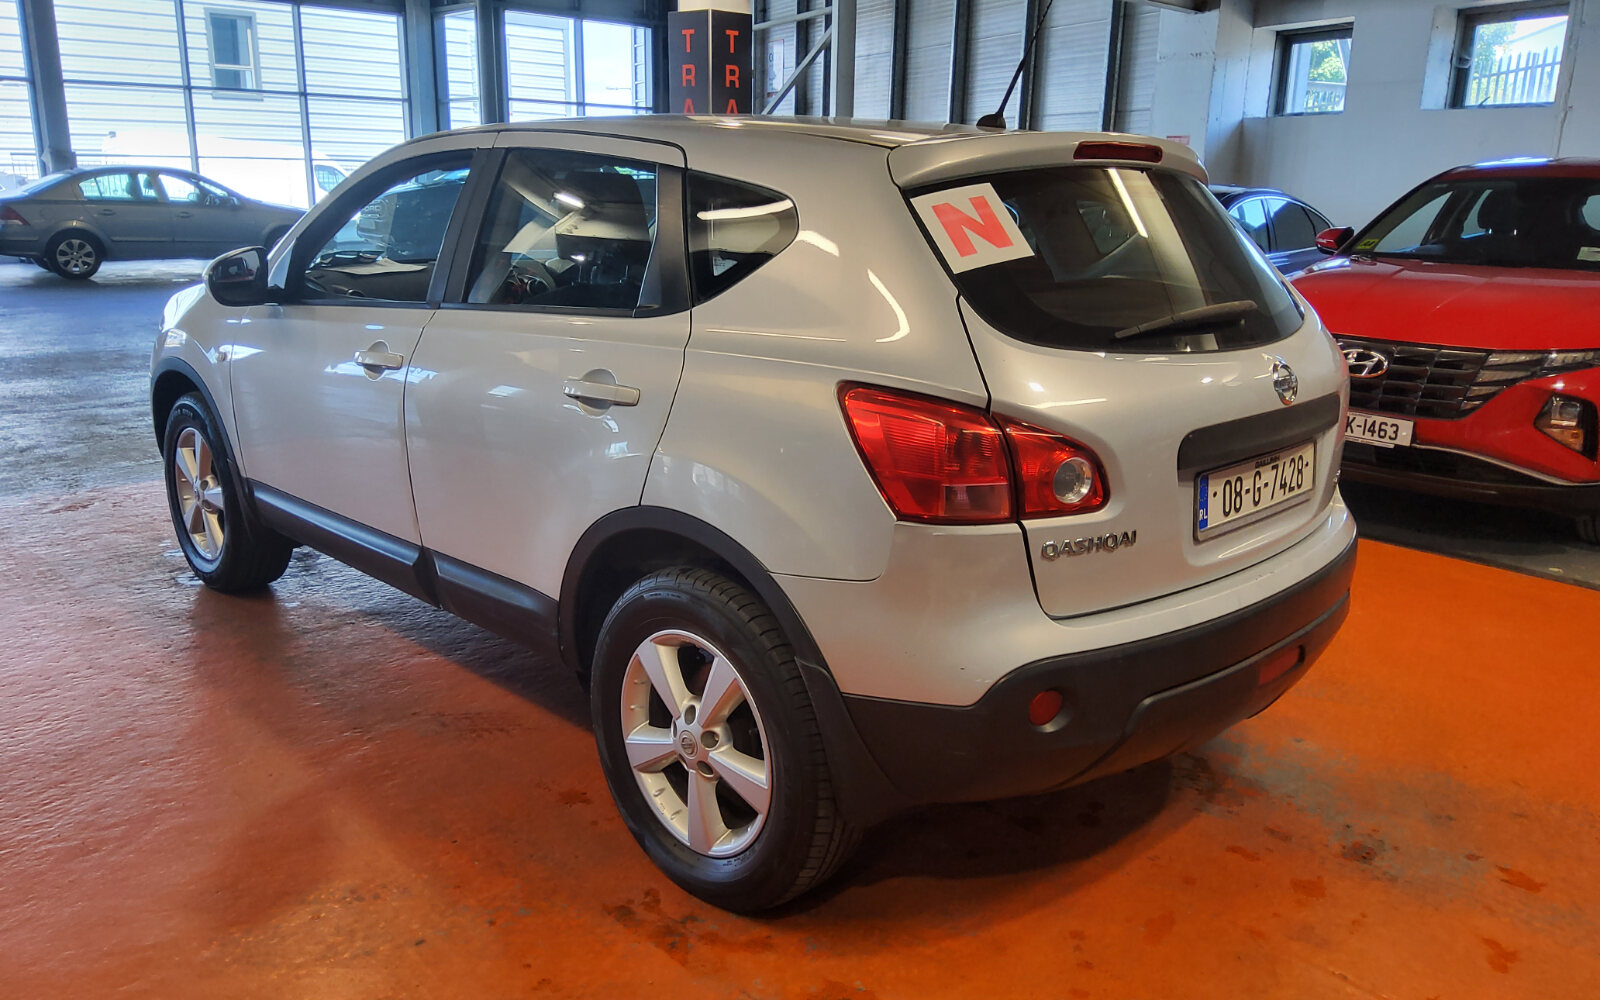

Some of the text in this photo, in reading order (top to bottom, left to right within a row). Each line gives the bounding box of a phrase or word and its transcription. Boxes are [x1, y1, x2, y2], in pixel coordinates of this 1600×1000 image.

[931, 195, 1014, 257] N
[1222, 454, 1304, 517] 08-G-7428
[1199, 508, 1208, 520] RL
[1041, 530, 1137, 560] QASHQAI
